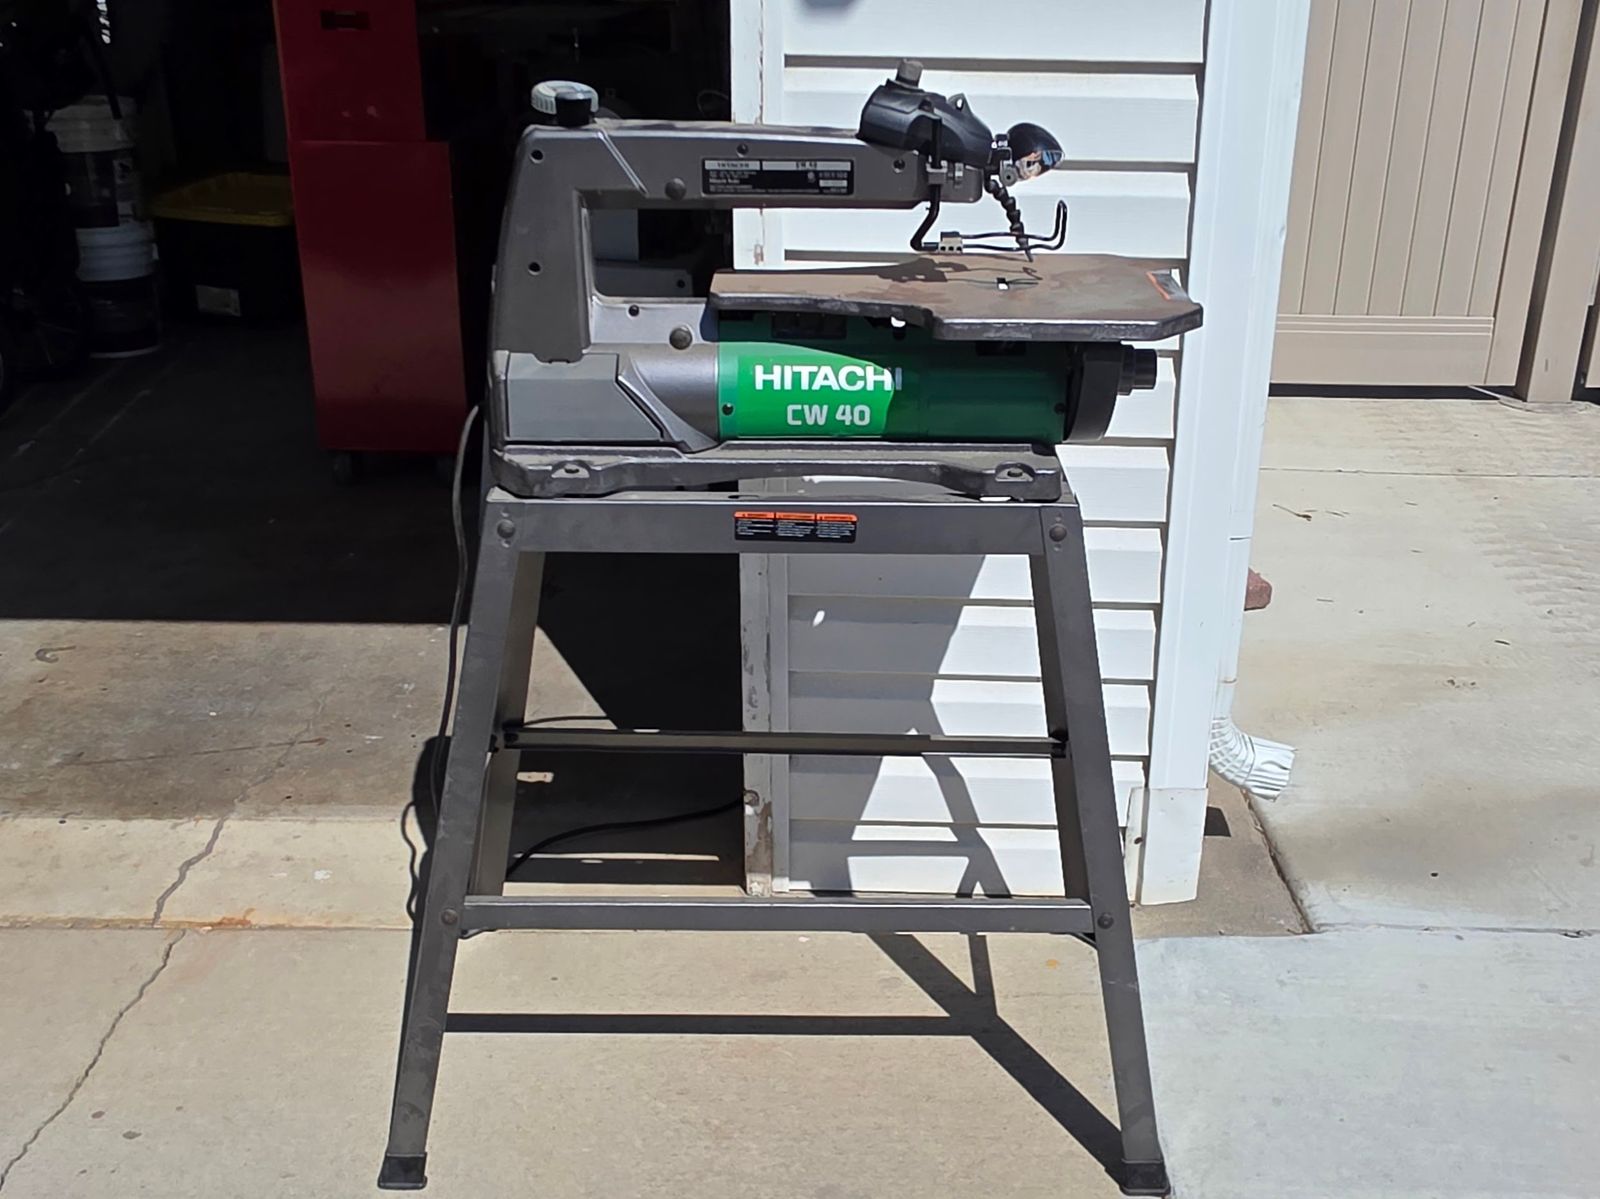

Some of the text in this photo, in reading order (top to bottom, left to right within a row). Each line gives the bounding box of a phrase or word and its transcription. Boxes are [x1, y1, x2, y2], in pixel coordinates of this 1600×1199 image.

[755, 365, 902, 391] HITACHI
[787, 404, 871, 426] CW 40
